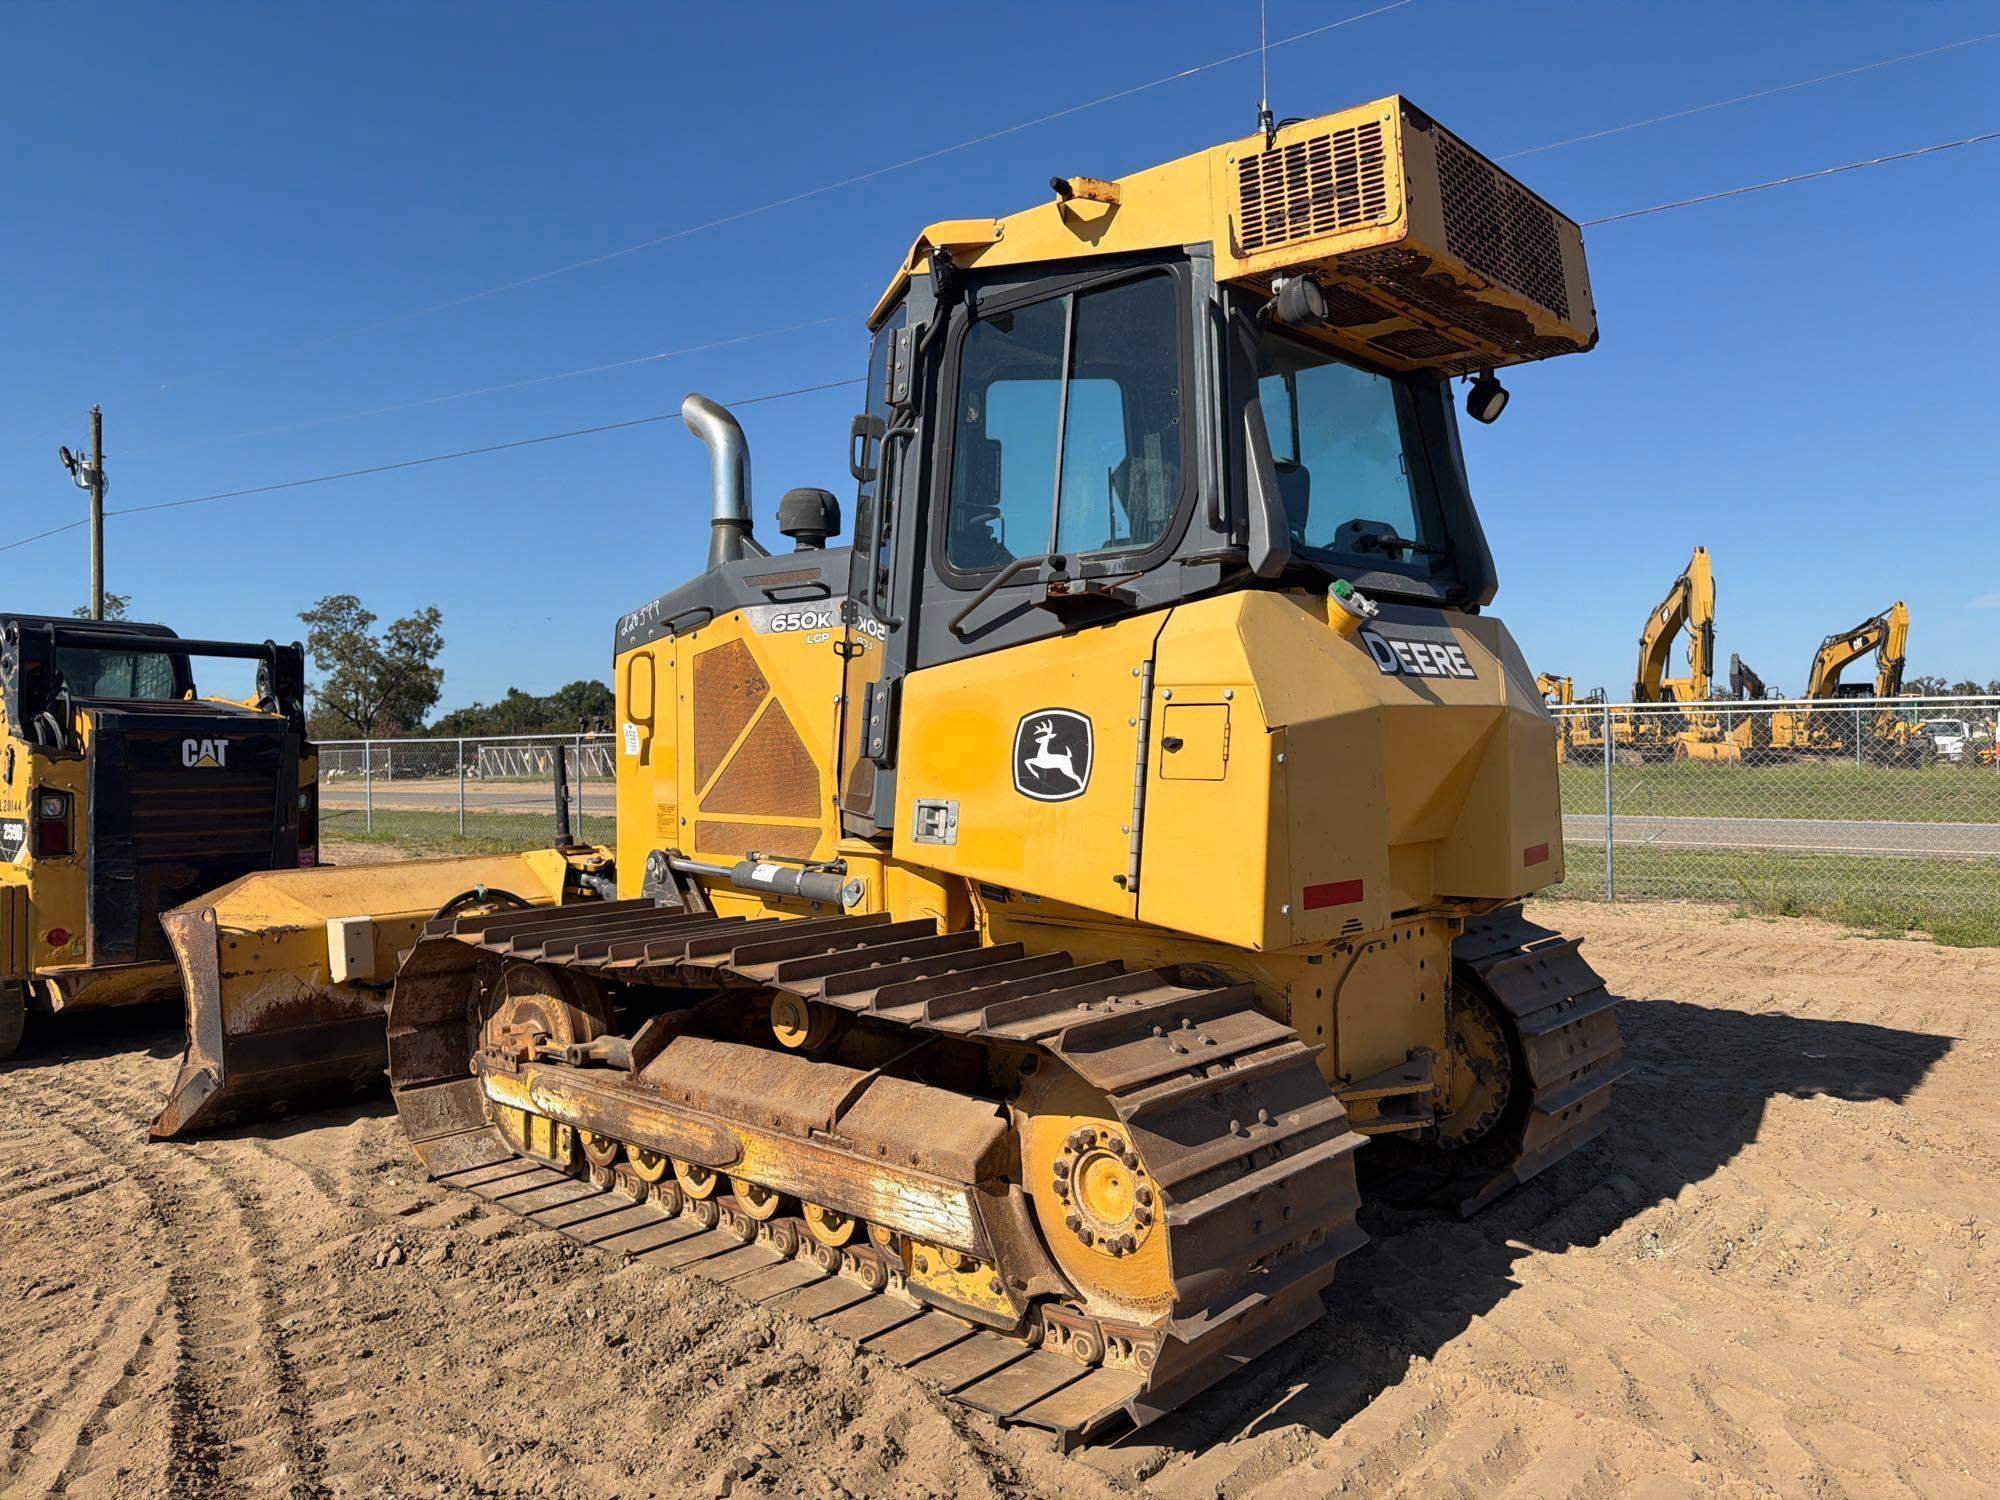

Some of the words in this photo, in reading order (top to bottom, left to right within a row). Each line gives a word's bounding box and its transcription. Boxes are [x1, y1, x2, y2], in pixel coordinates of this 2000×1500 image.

[771, 610, 833, 633] 650K
[806, 632, 830, 645] LGP
[1358, 629, 1478, 680] DEERE
[182, 738, 229, 768] CAT
[3, 823, 23, 841] 259D
